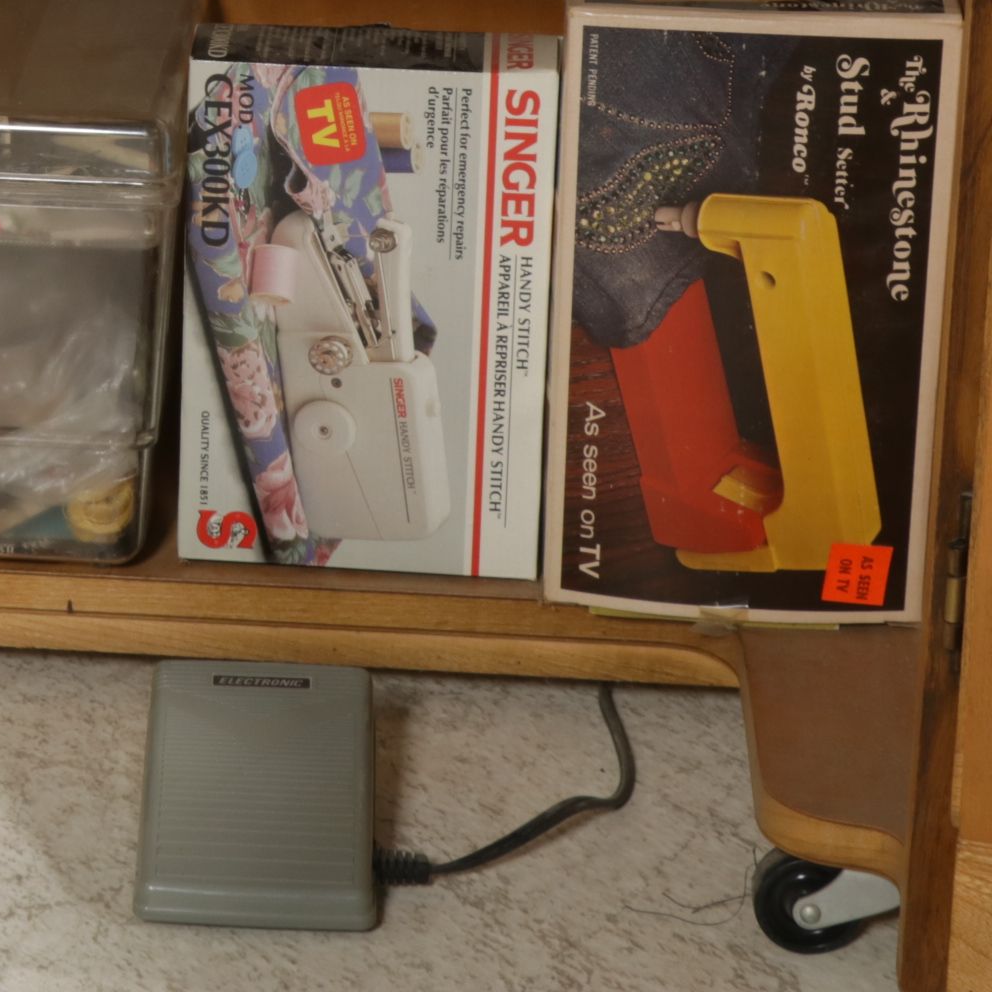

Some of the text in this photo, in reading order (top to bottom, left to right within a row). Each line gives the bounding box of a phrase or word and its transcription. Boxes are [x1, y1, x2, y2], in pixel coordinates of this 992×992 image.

[587, 33, 600, 107] PATENT PENDING
[799, 65, 817, 82] by
[880, 88, 897, 106] &
[238, 73, 255, 129] MOD.
[307, 99, 340, 149] TV
[342, 96, 350, 108] AS
[344, 109, 355, 132] SEEN
[424, 86, 438, 150] d'urgence
[201, 73, 234, 247] CEX300KD
[349, 133, 358, 146] ON
[833, 54, 871, 211] Stud Setter
[435, 87, 454, 244] Parfait pour les réparations
[453, 87, 473, 261] Perfect for emergency repairs
[500, 89, 540, 247] SINGER
[886, 55, 934, 303] The Rhinestone
[497, 254, 512, 319] APPAREIL
[518, 256, 533, 313] HANDY
[494, 335, 509, 397] REPRISER
[393, 377, 407, 418] SINGER
[399, 421, 412, 453] HANDY
[491, 400, 506, 455] HANDY
[199, 410, 211, 505] QUALITY SINCE 1851
[579, 402, 606, 580] As seen on TV
[836, 558, 853, 594] ON TV
[855, 556, 874, 601] AS SEEN
[218, 677, 304, 688] ELECTRONIC
